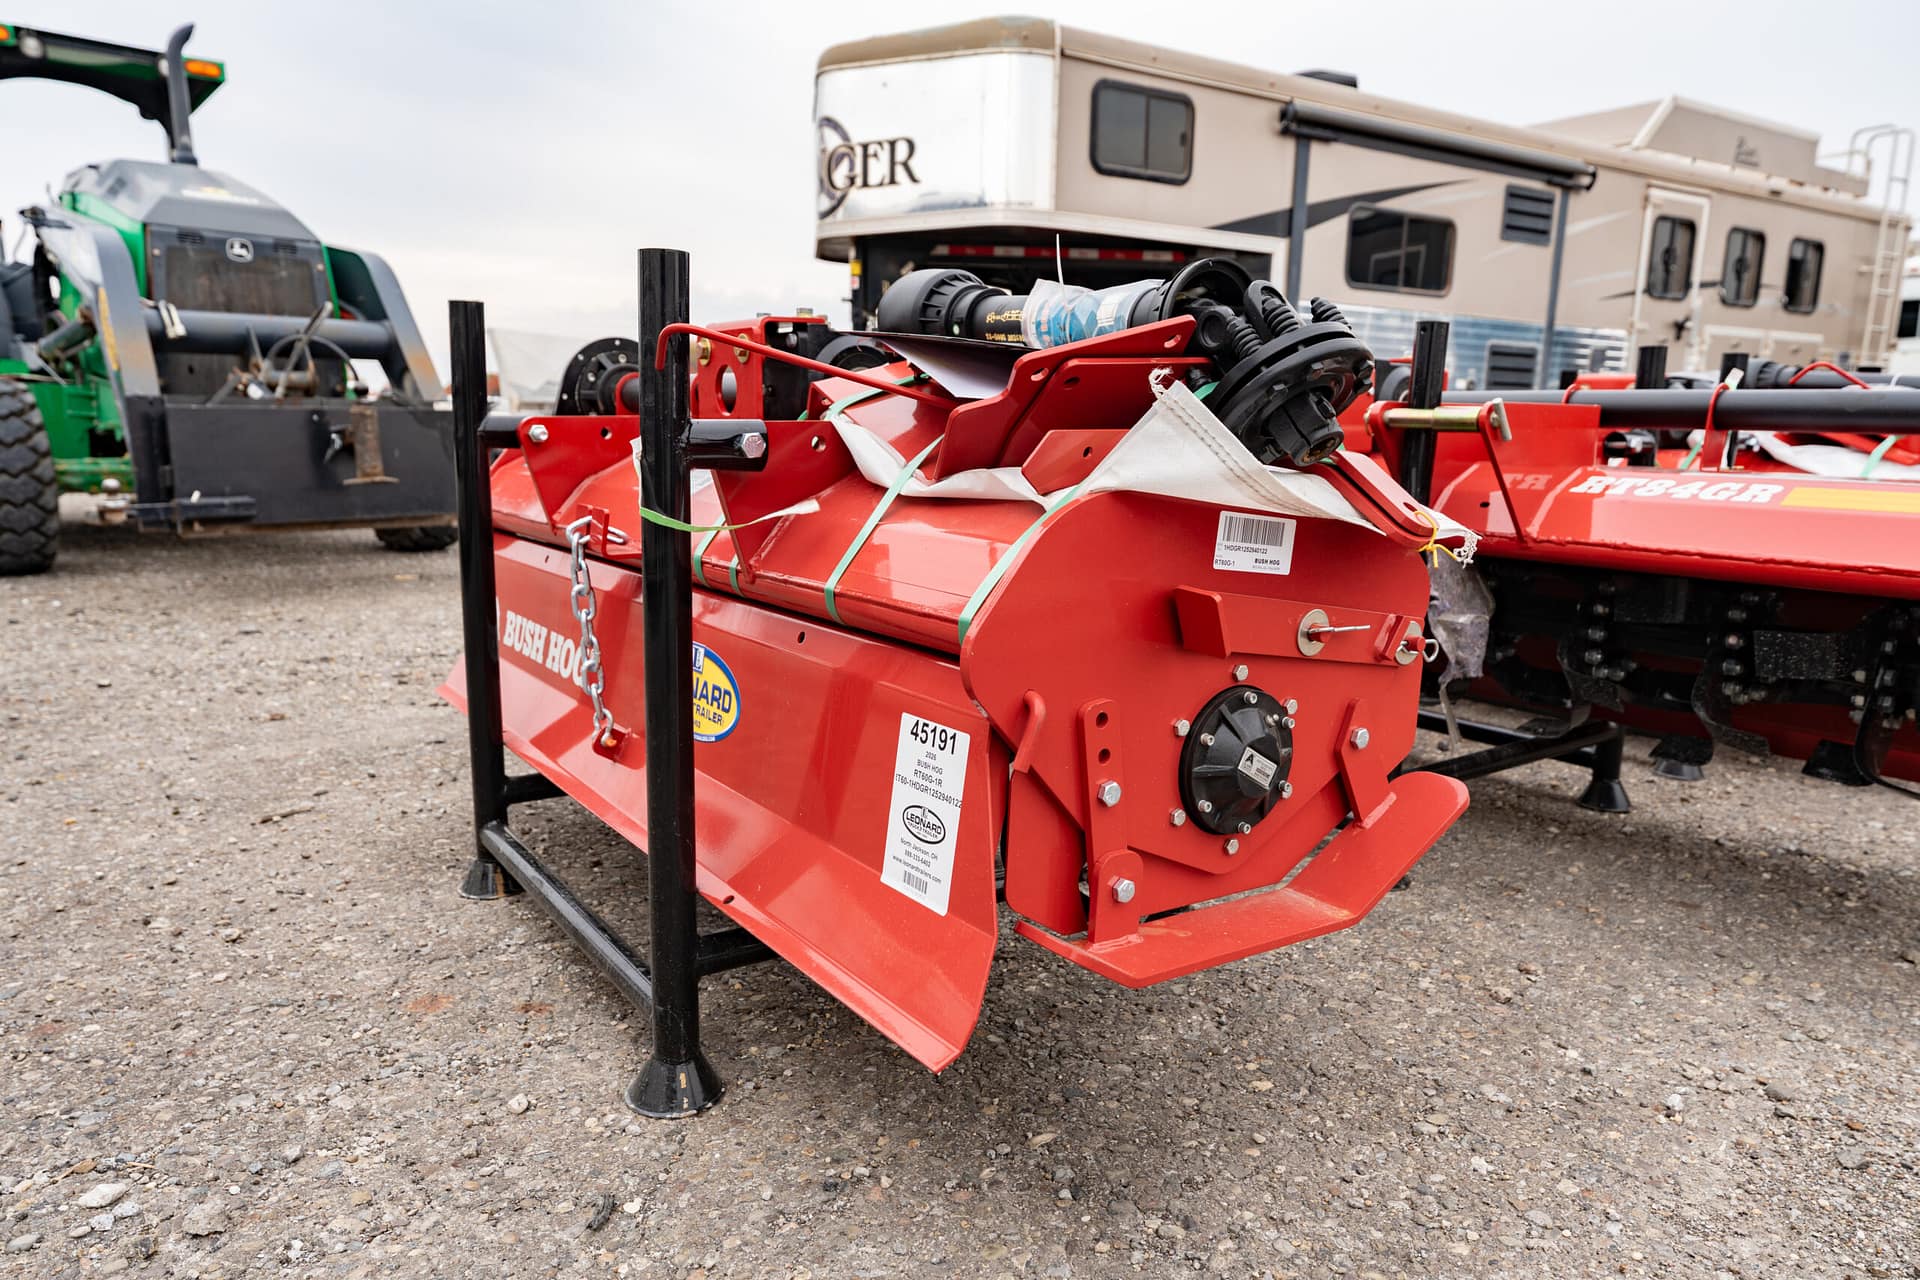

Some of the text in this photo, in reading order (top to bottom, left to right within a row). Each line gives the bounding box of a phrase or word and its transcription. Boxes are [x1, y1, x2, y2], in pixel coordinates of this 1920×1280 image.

[1569, 475, 1784, 503] RT84GR
[1254, 557, 1269, 565] BUSH
[503, 610, 548, 664] BUSH
[910, 719, 957, 755] 45191
[913, 769, 943, 788] RT60G-1R
[917, 759, 944, 775] BUSH HOG
[906, 811, 942, 835] LEONARD
